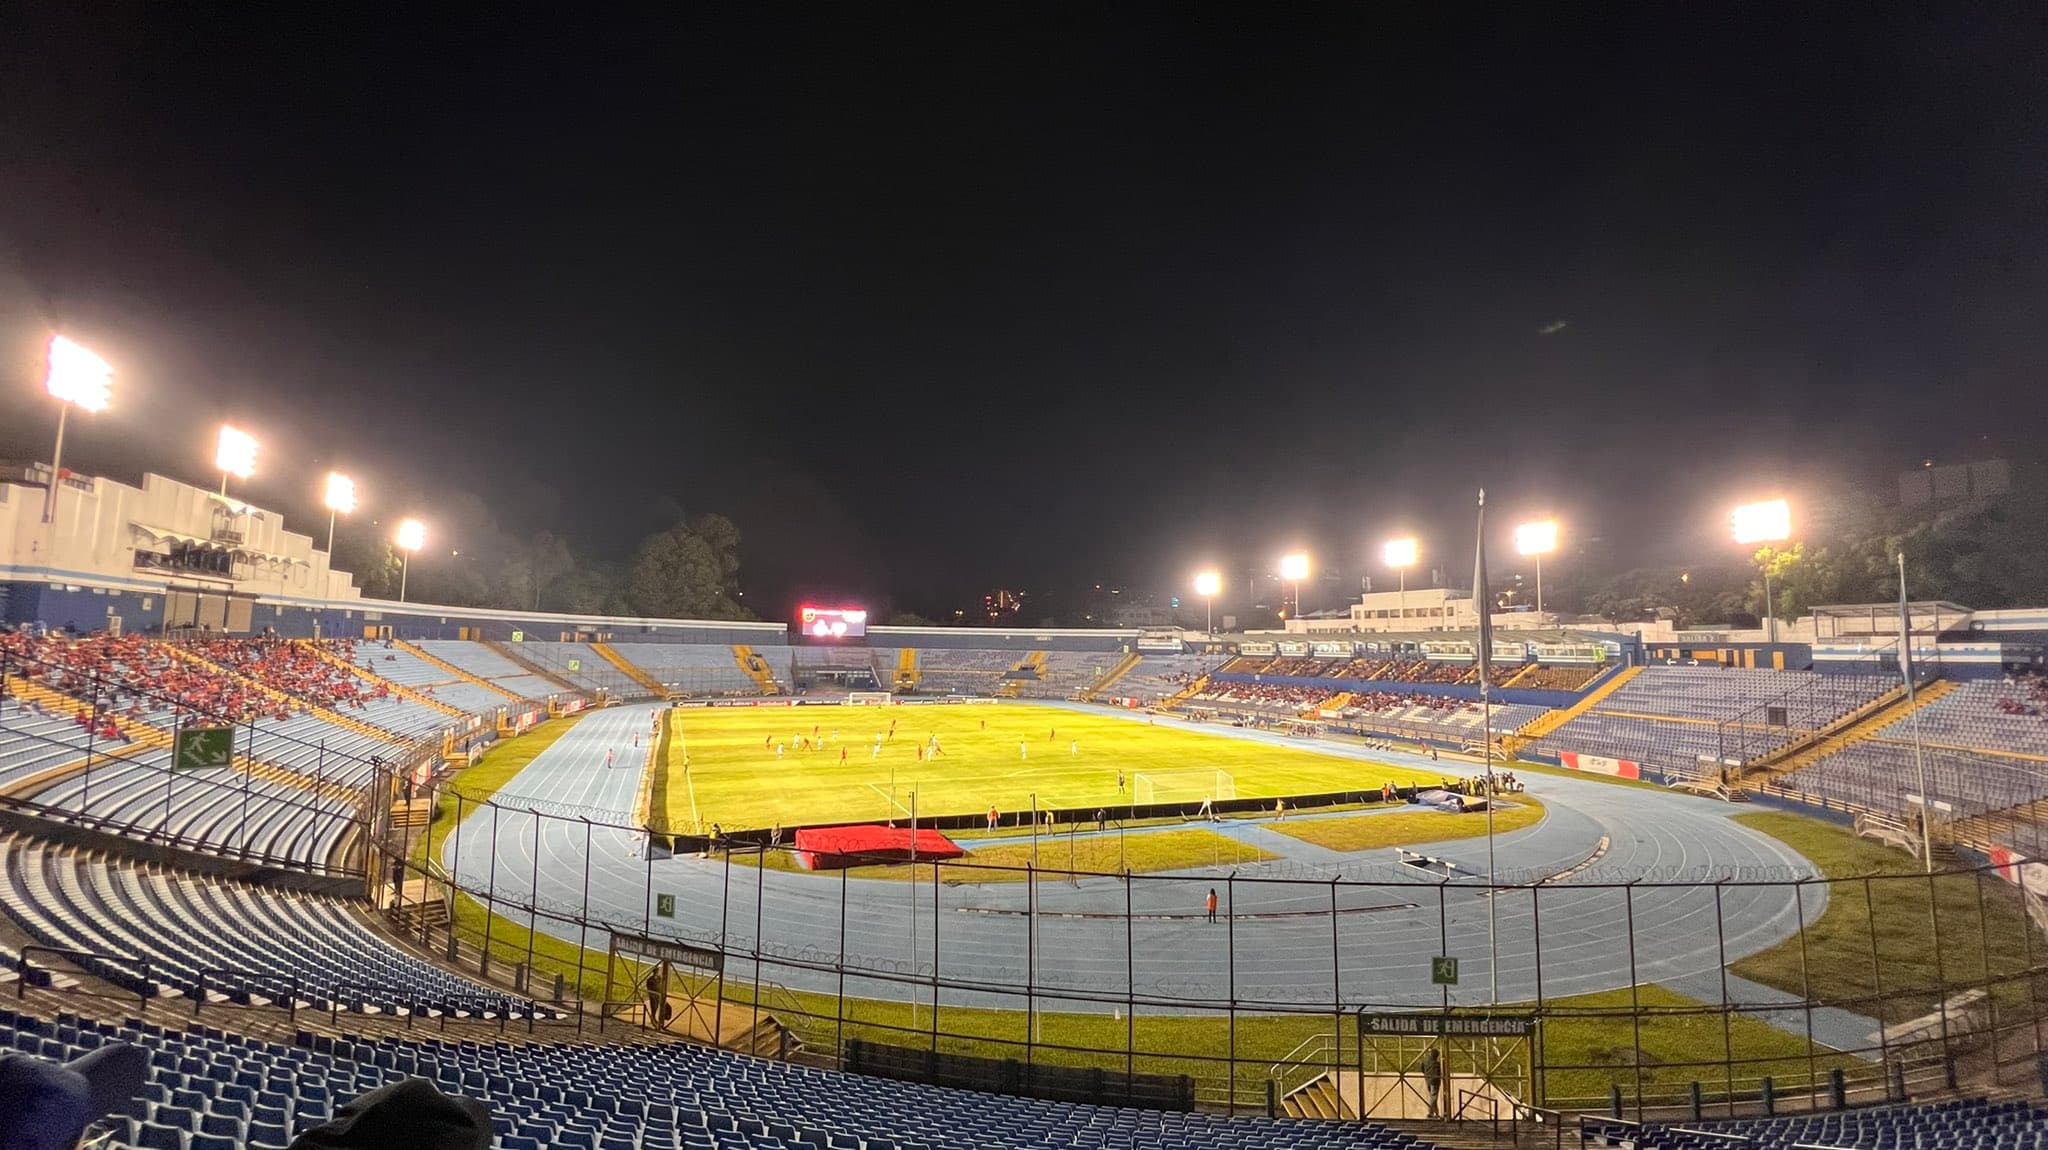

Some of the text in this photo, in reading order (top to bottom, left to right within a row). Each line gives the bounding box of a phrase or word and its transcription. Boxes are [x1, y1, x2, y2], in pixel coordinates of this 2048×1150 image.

[615, 937, 714, 967] SALIDA DE EMERGENCIA
[1372, 1017, 1526, 1033] SALIDA DE EMERGENCIA
